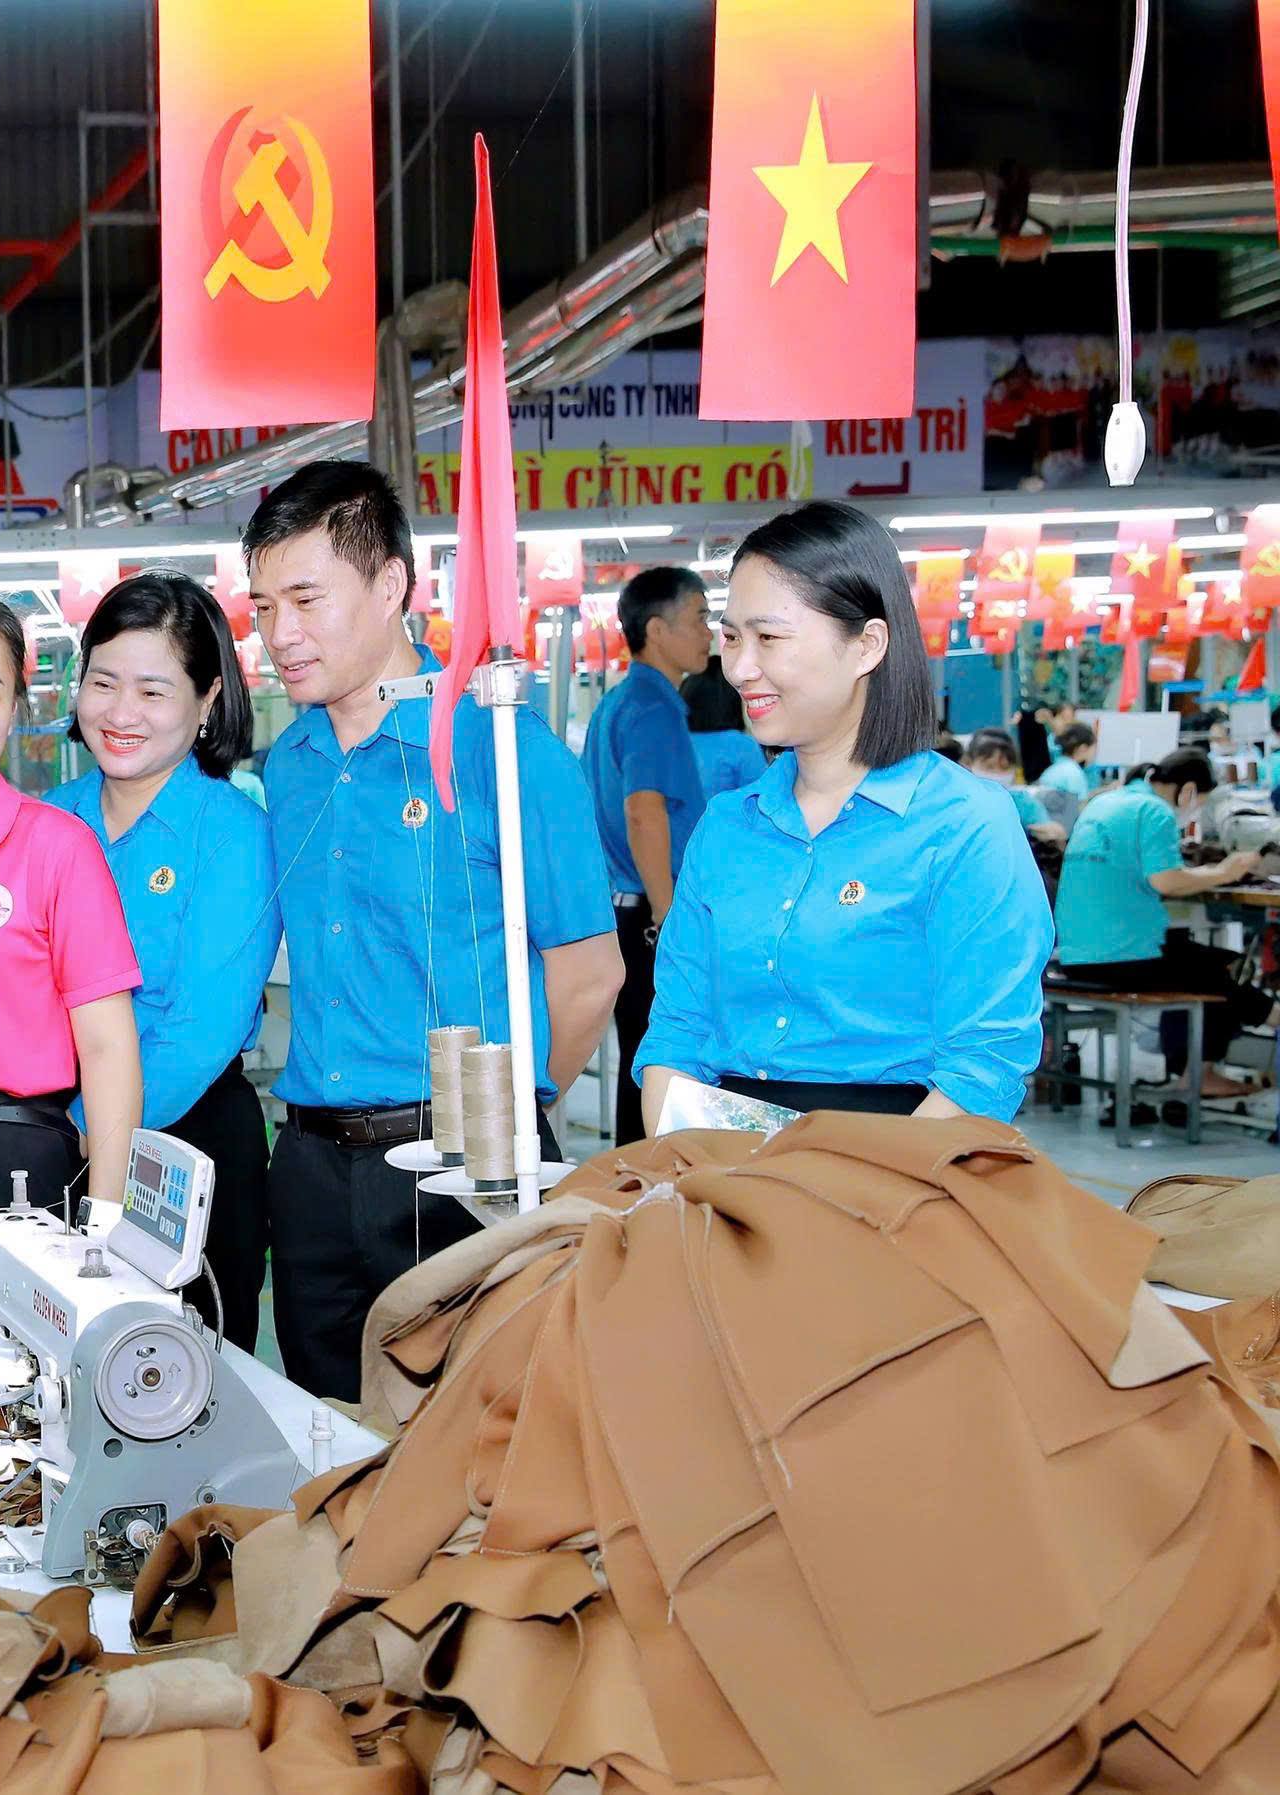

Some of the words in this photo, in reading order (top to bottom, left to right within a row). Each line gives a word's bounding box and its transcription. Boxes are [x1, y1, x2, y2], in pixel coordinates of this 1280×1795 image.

[623, 384, 646, 417] TY
[917, 397, 967, 453] TRÌ
[724, 449, 789, 502] CÓ
